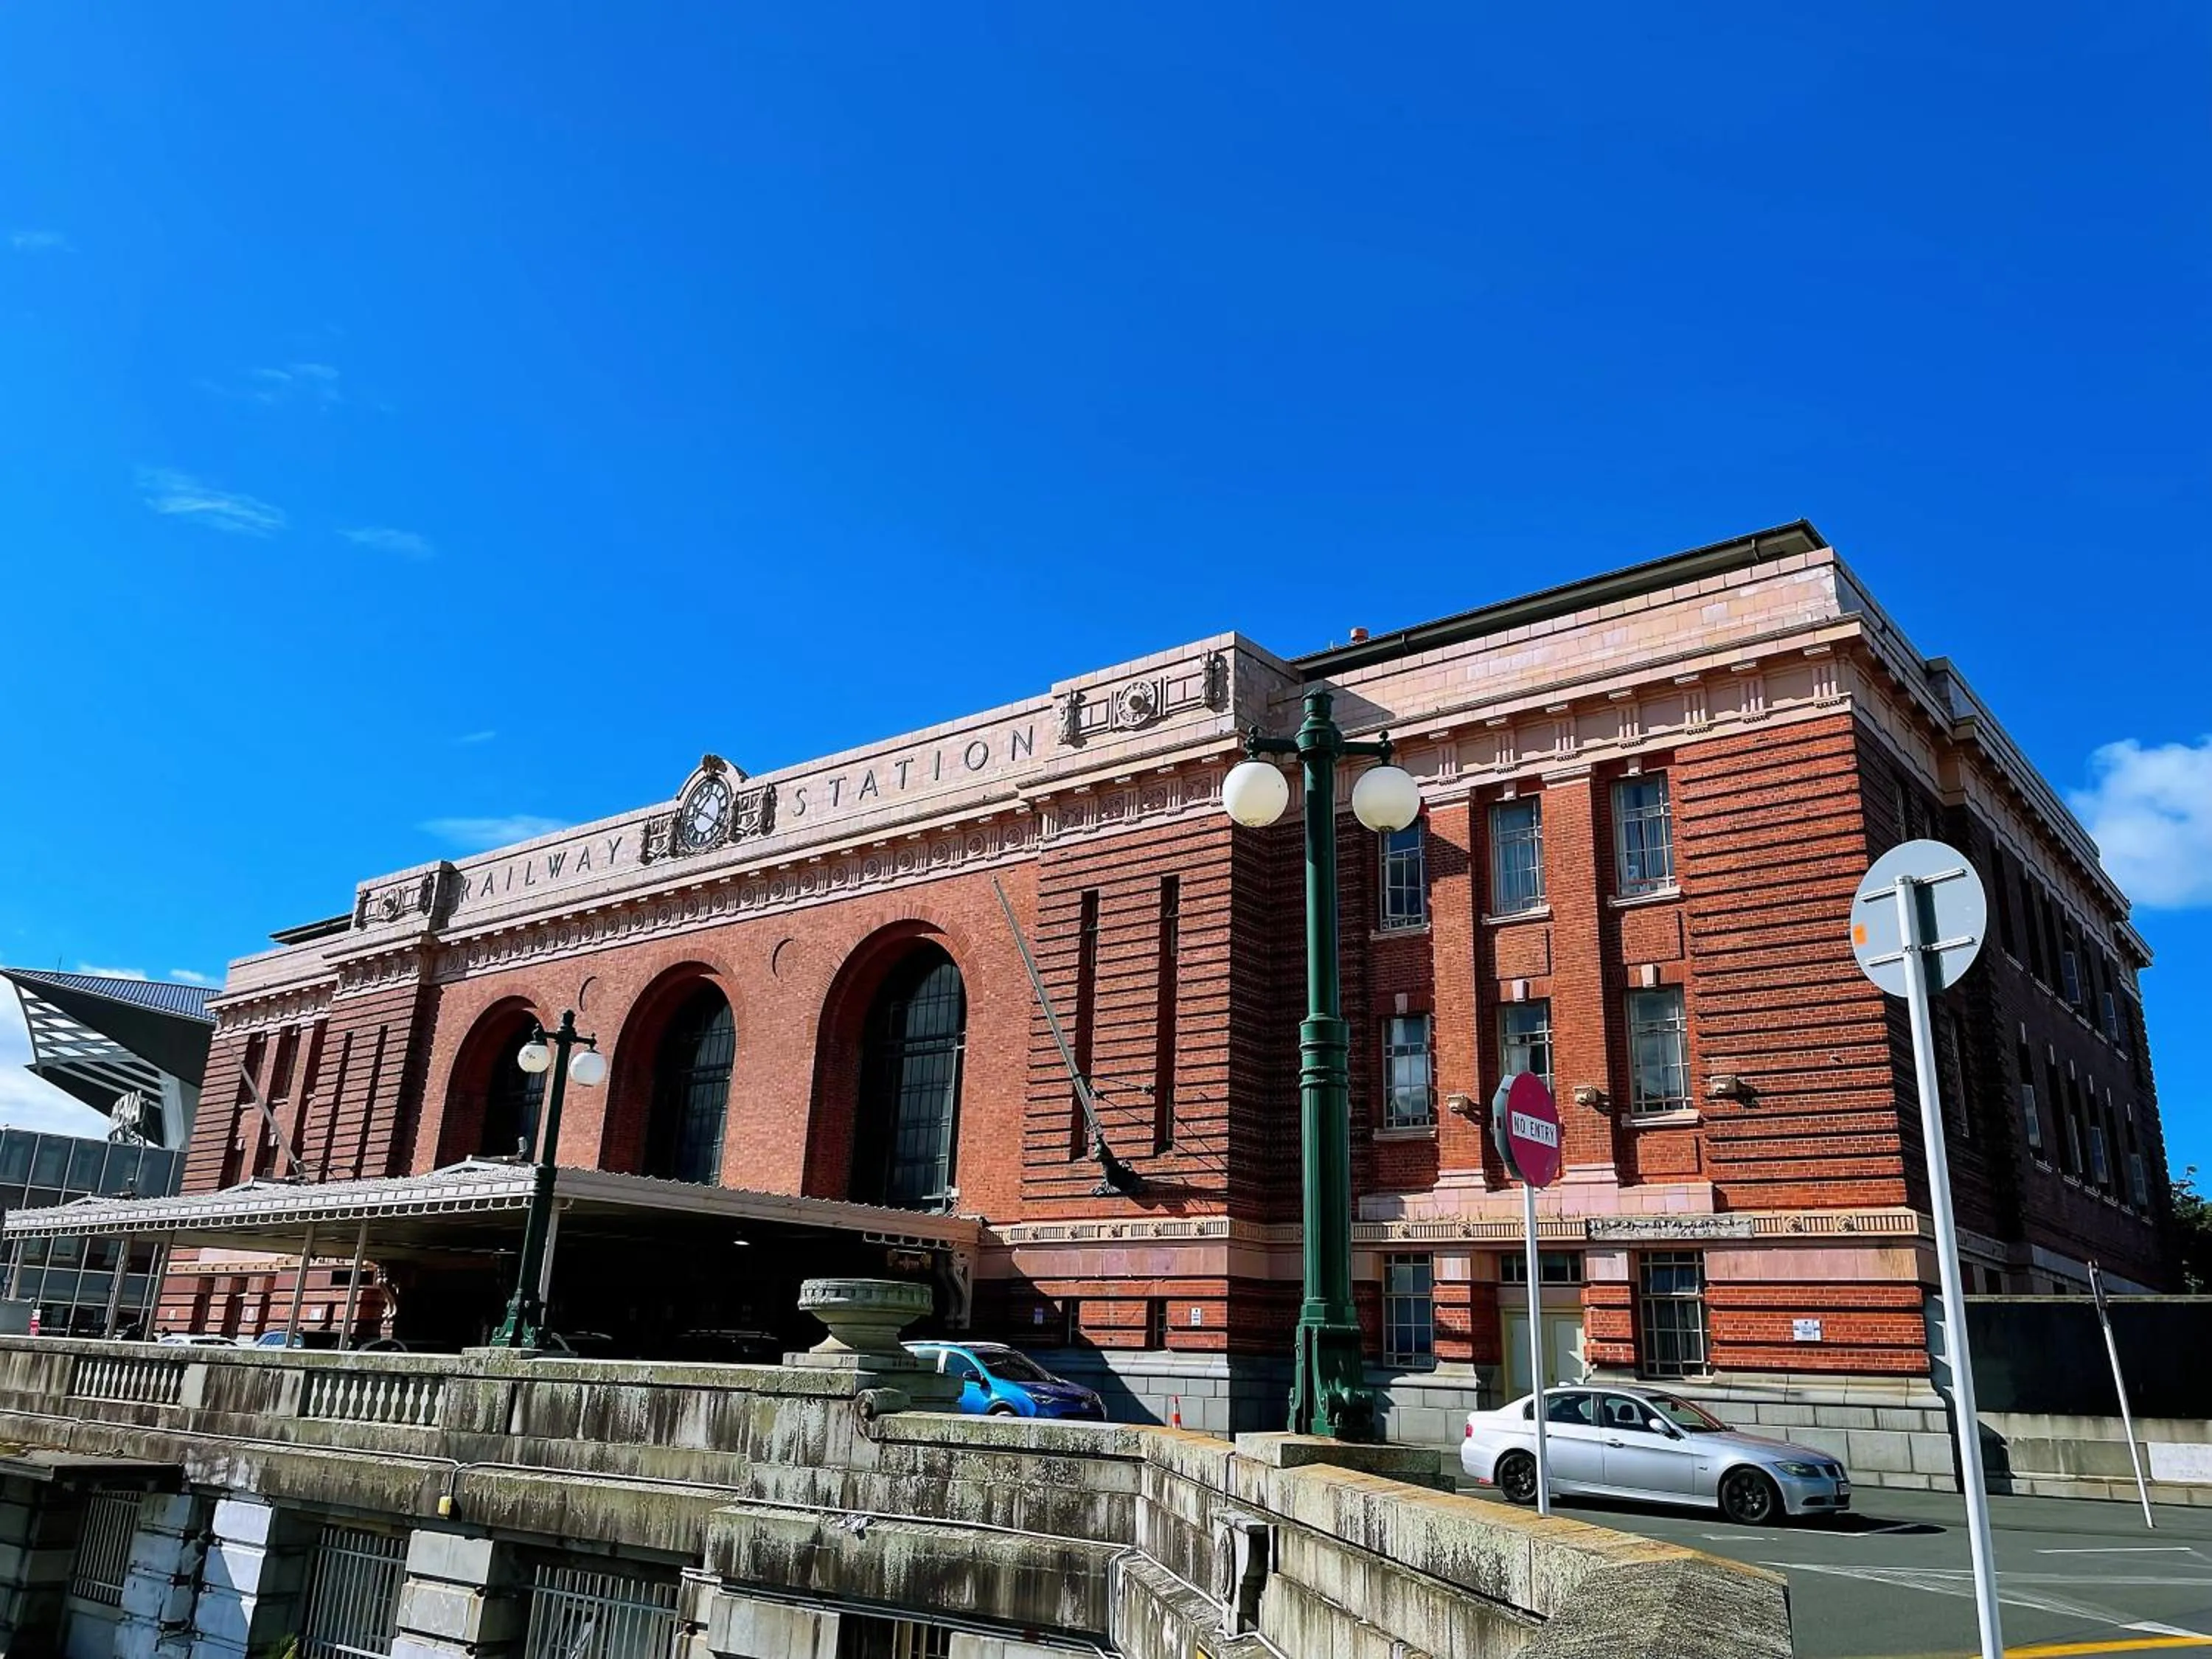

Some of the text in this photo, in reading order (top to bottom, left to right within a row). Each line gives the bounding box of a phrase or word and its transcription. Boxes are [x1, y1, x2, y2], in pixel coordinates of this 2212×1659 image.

[459, 725, 1033, 903] RAILWAY STATION
[1514, 1116, 1554, 1143] NO ENTRY
